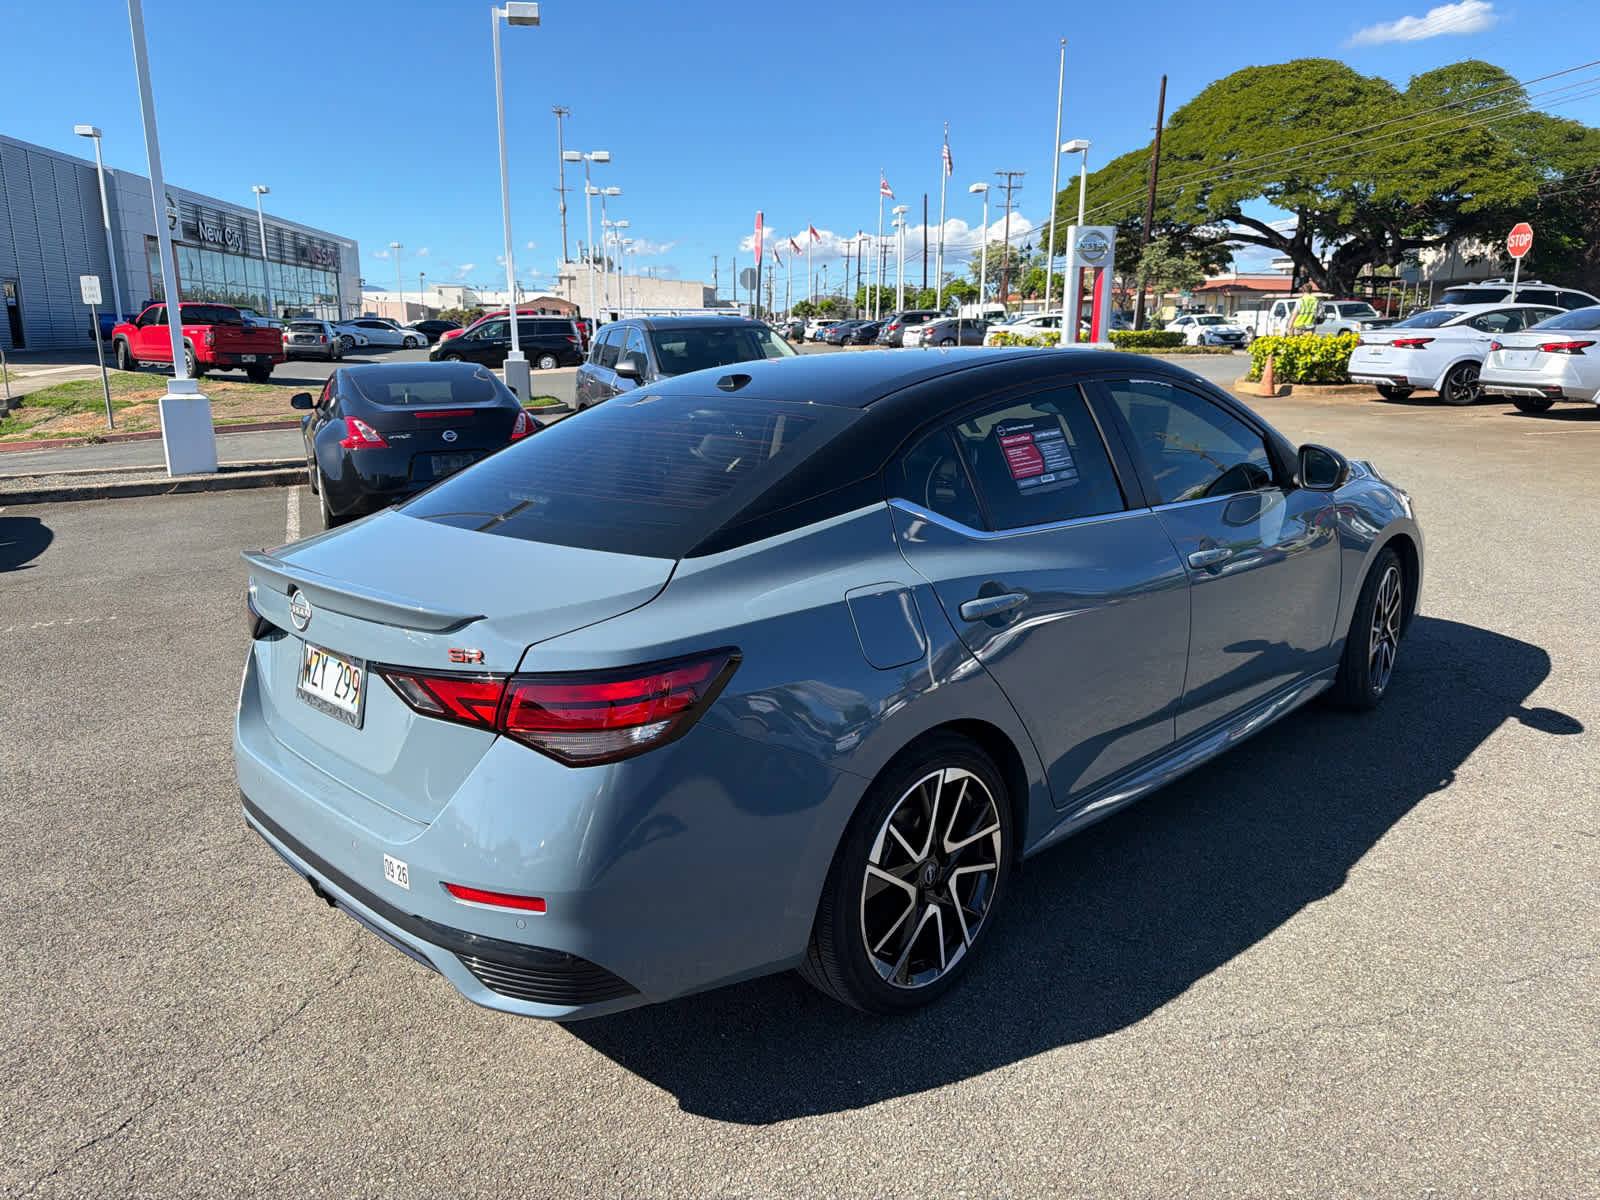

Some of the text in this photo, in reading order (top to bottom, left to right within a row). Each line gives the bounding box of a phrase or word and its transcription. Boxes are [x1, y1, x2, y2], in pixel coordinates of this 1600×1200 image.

[199, 219, 243, 252] New City
[1509, 233, 1531, 248] STOP
[307, 246, 337, 267] NISSAN
[447, 648, 485, 664] SR
[304, 647, 361, 704] WZY 299
[384, 858, 408, 885] 09 26
